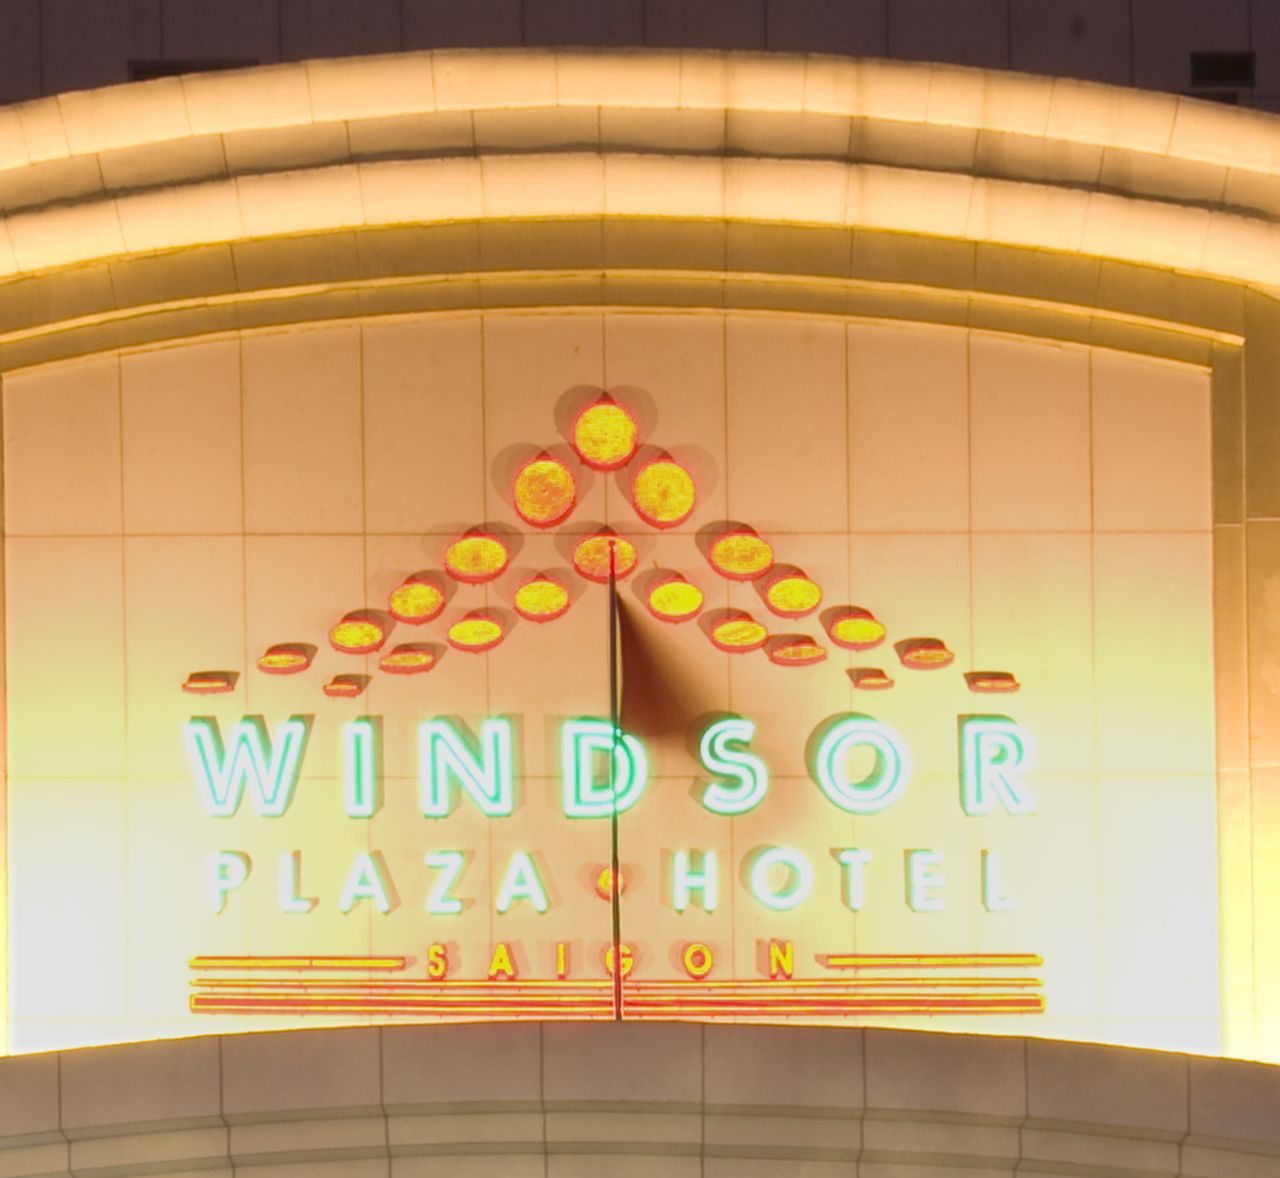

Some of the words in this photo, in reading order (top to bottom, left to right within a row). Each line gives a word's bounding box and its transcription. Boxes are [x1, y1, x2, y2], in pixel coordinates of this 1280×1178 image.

[183, 716, 1038, 818] WINDSOR
[206, 850, 549, 914] PLAZA
[671, 846, 1017, 913] HOTEL
[428, 940, 794, 981] SAIGON
